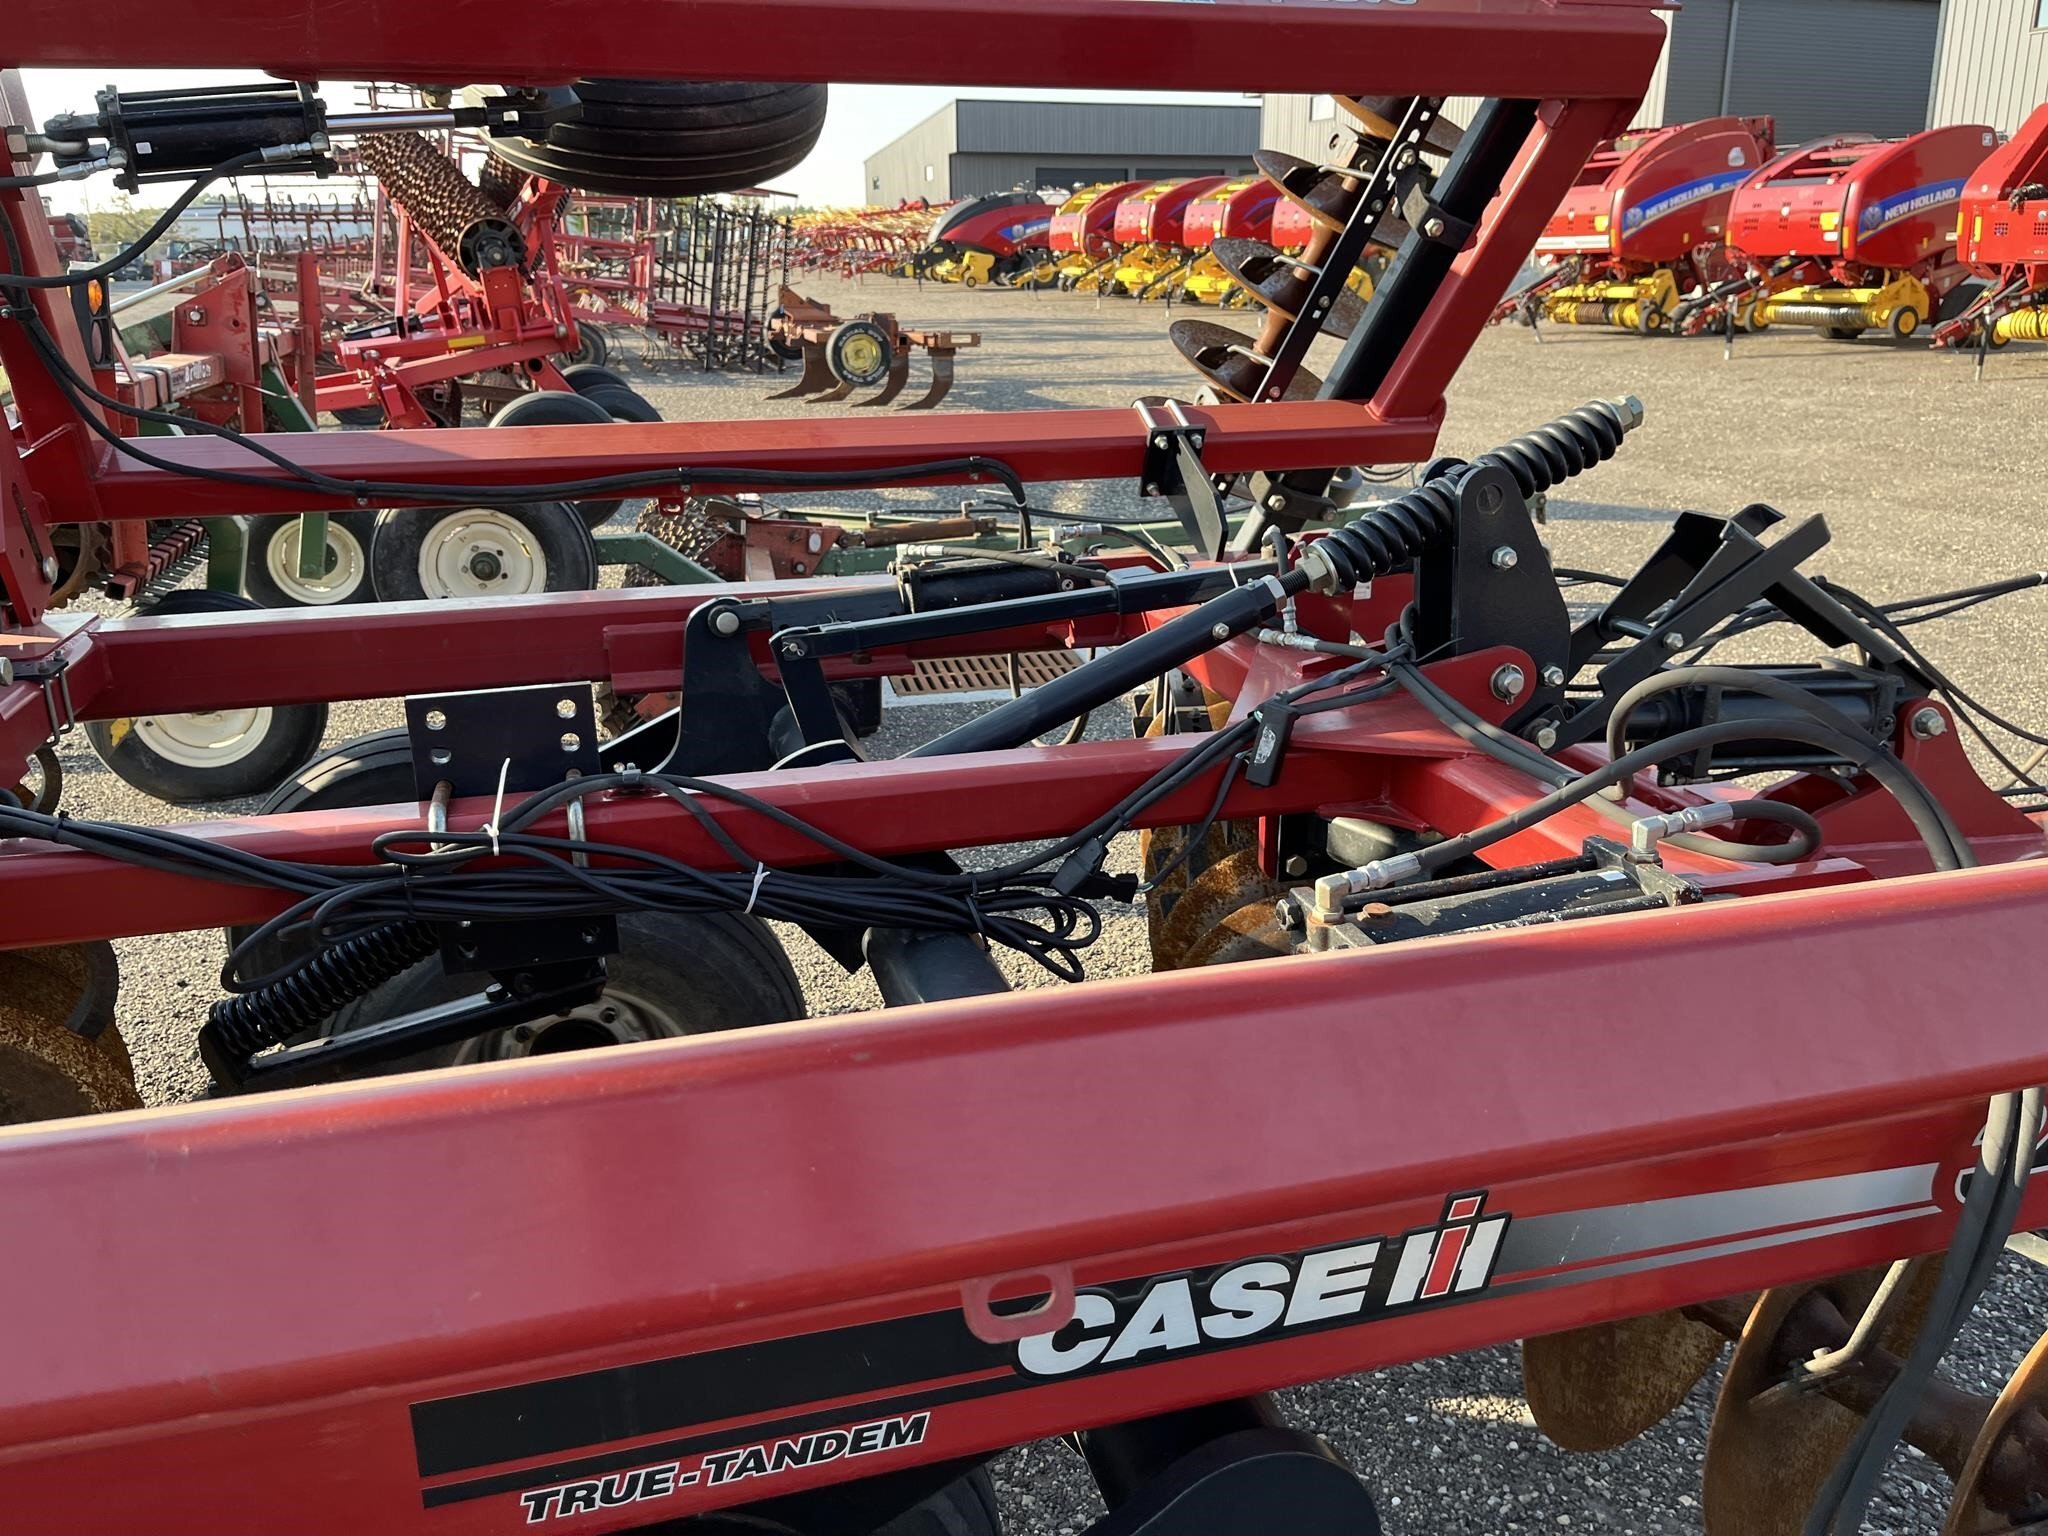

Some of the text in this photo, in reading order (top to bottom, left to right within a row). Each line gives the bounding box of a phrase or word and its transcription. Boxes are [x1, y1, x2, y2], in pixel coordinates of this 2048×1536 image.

[1645, 202, 1670, 220] NEW
[1669, 183, 1714, 209] HOLLAND
[1885, 187, 1956, 221] NEW HOLLAND
[1017, 1241, 1381, 1376] CASE
[519, 1411, 932, 1525] TRUE-TANDEM
